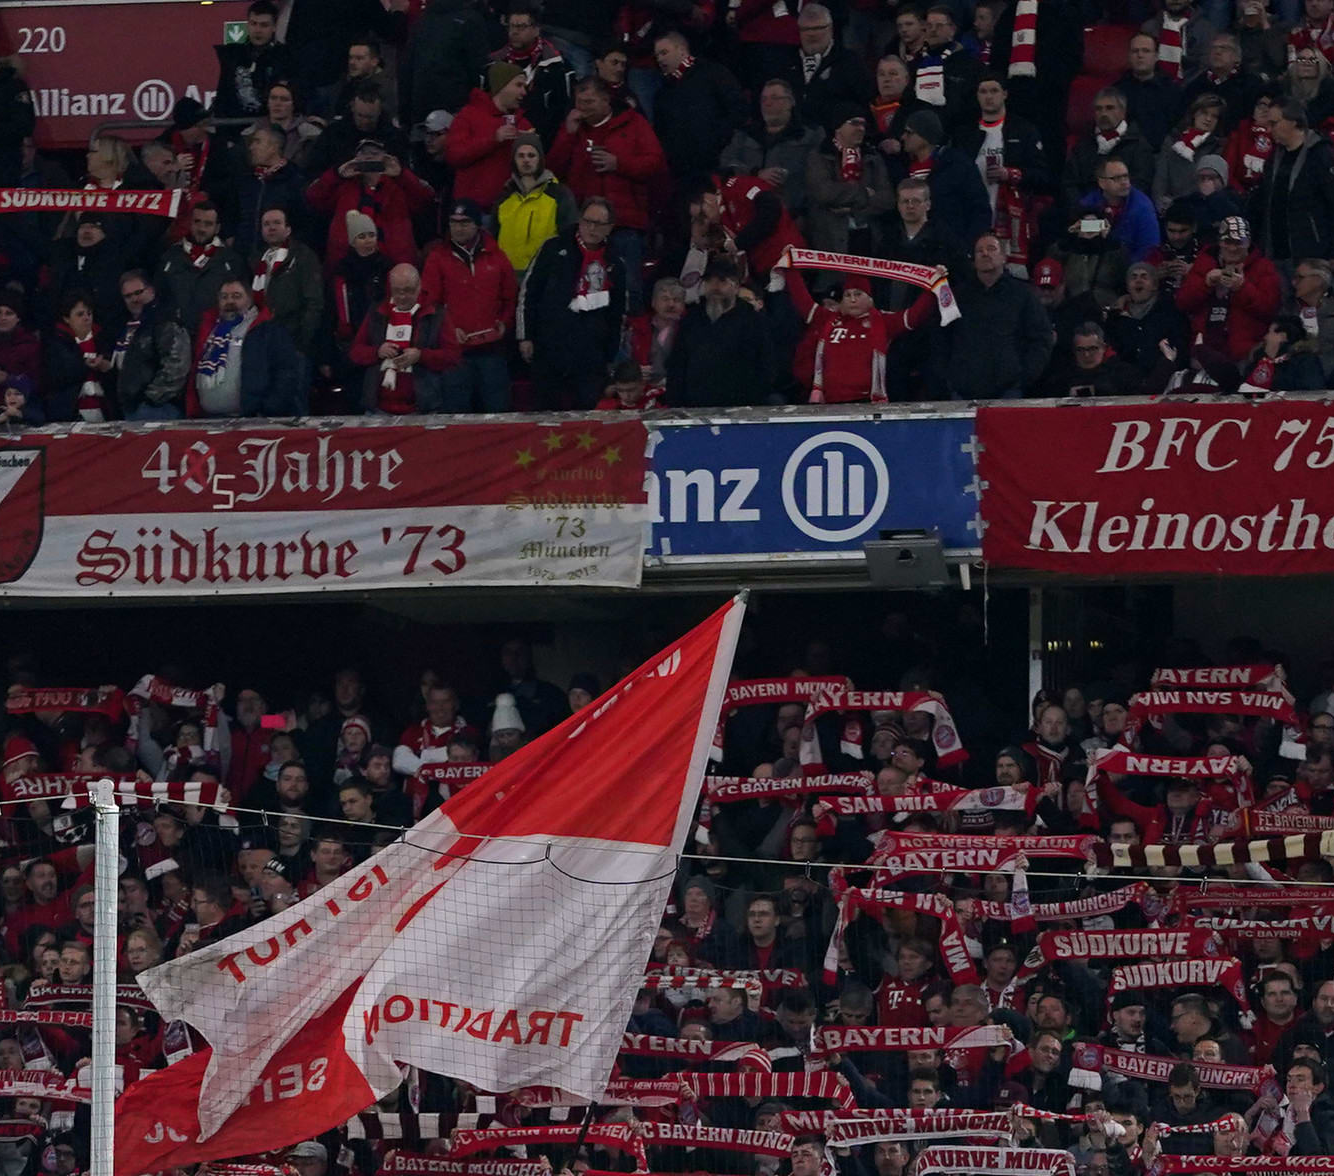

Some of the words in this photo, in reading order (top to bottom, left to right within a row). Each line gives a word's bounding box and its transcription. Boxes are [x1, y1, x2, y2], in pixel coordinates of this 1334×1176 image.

[18, 27, 66, 52] 220
[797, 250, 813, 262] FC
[815, 251, 866, 269] BAYERN
[868, 257, 936, 281] MÜNCHEN
[1096, 418, 1251, 474] BFC
[840, 798, 885, 813] SAN
[1004, 904, 1060, 920] BERN
[1056, 930, 1190, 957] SÜDKURVE
[824, 1027, 945, 1049] BAYERN
